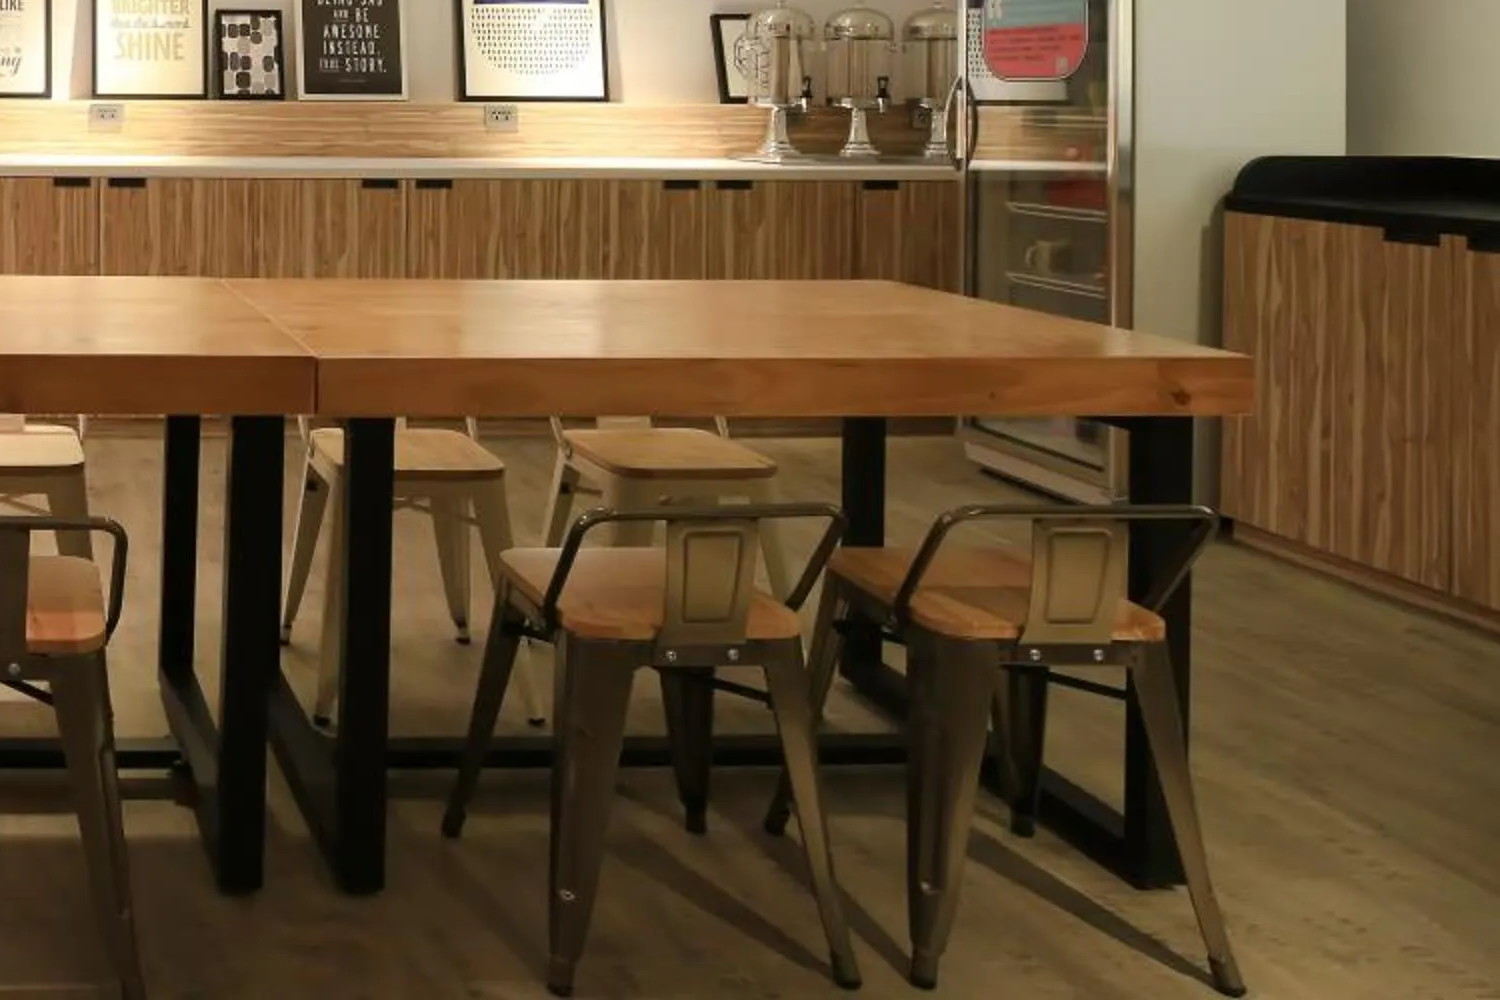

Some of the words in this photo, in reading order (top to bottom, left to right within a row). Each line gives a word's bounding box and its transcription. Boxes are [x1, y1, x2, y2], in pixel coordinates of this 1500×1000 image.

[355, 7, 369, 23] BE
[323, 23, 380, 39] AWESOME
[113, 31, 185, 61] SHINE
